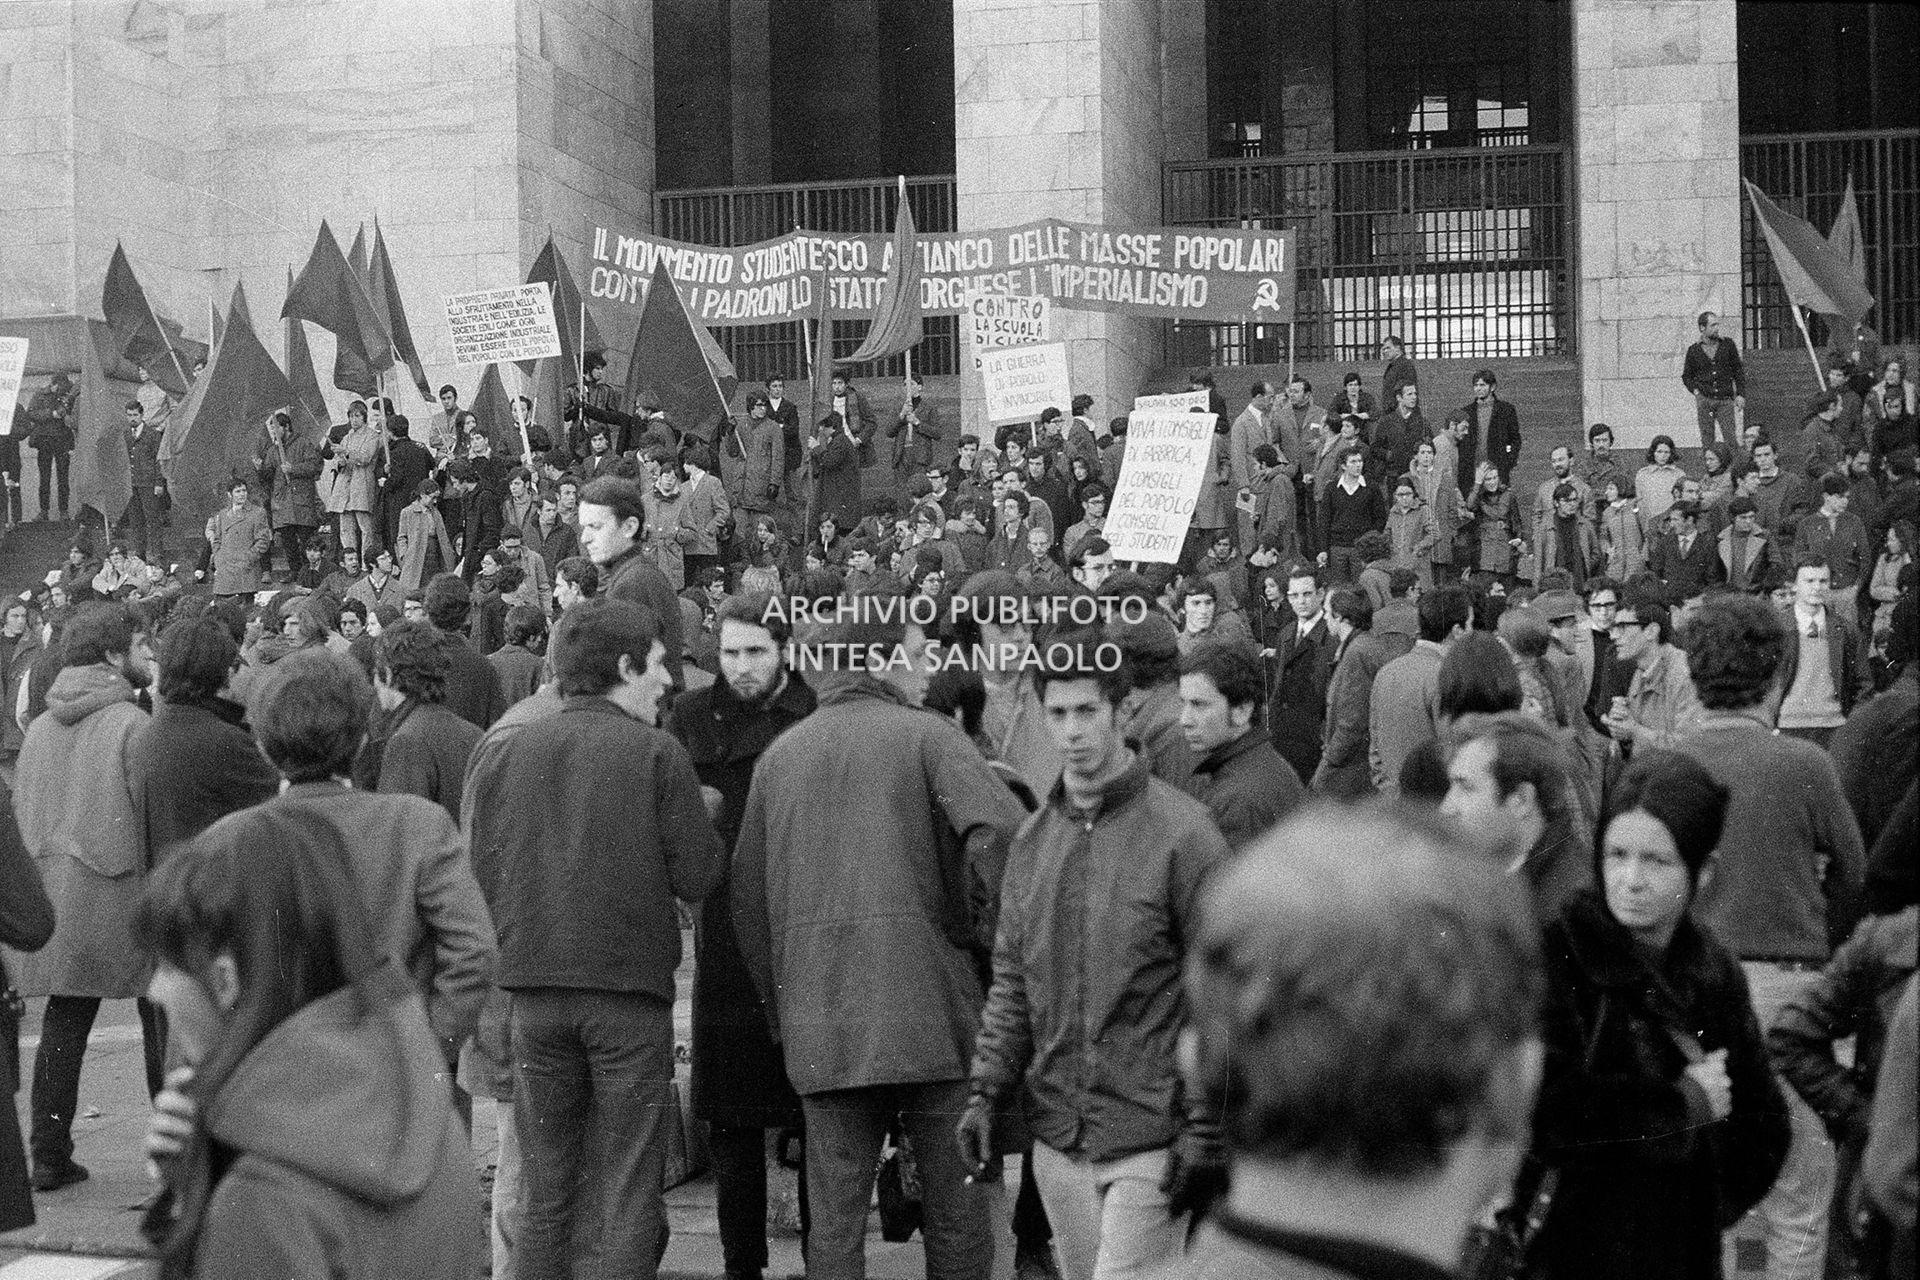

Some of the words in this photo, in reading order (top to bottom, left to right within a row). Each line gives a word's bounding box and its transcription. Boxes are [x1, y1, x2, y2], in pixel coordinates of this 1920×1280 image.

[593, 227, 609, 261] IL
[615, 235, 733, 284] MOVIMENTO
[741, 236, 868, 284] STUDENTESCO
[916, 238, 993, 273] IANCO
[1008, 226, 1070, 265] DELLE
[1080, 231, 1162, 268] MASSE
[1174, 235, 1285, 272] POPOLARI
[520, 287, 542, 297] PORTA
[920, 271, 1021, 309] ORGHESE
[1029, 263, 1208, 308] L'IMPERIALISMO
[449, 314, 483, 325] INDUSTRIA
[537, 306, 546, 315] LE
[465, 302, 514, 314] SFRUTTAMENTO
[516, 298, 537, 307] NELLA
[974, 298, 1043, 319] CONTRO
[496, 321, 517, 330] COME
[519, 318, 536, 327] OGNI
[975, 318, 989, 331] LA
[994, 318, 1043, 337] SCUOLA
[454, 332, 508, 344] ORGANIZZAZIONE
[509, 326, 551, 338] INDUSTRIALE
[976, 335, 990, 345] DI
[480, 341, 507, 351] ESSERE
[989, 360, 1002, 374] LA
[1006, 353, 1047, 371] GUERRA
[1129, 420, 1155, 439] VIVA
[1164, 420, 1211, 441] CONSIGLI
[1128, 445, 1138, 462] DI
[1130, 470, 1183, 490] CONSIGLI
[1118, 492, 1137, 510] DEL
[1141, 492, 1195, 516] POPOLO
[1117, 512, 1167, 531] CONSIGLI
[1128, 531, 1180, 552] STUDENTI
